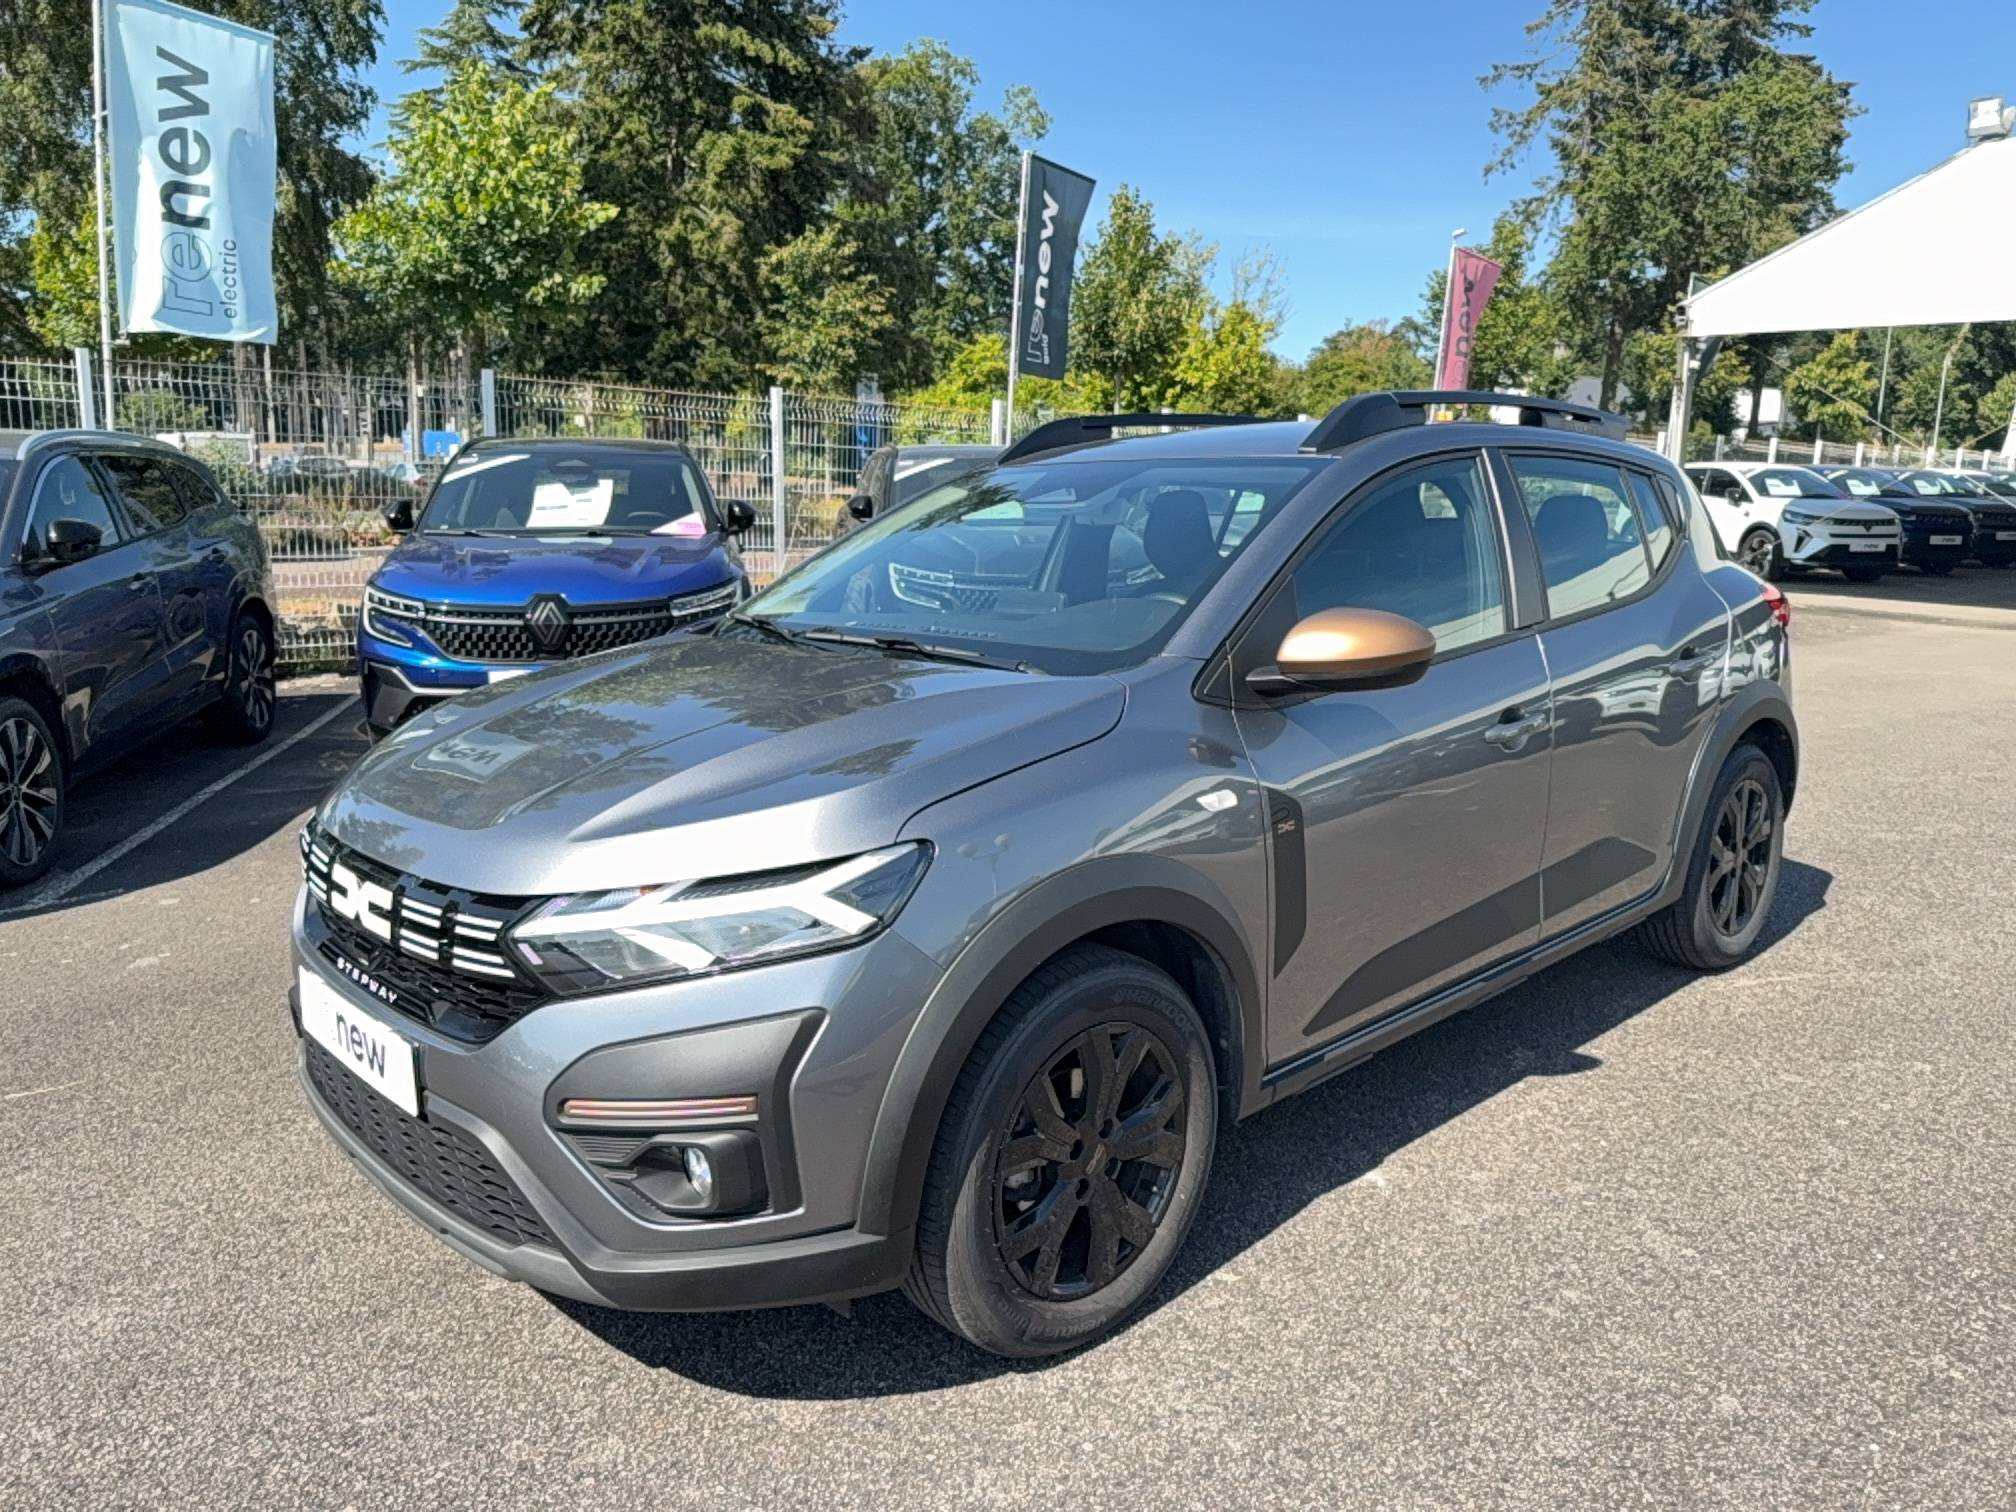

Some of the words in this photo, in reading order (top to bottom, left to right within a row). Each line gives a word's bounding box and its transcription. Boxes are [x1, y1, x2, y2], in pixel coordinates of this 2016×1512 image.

[156, 45, 213, 317] renew
[219, 238, 237, 319] electric
[1026, 189, 1059, 364] renew
[336, 957, 397, 1004] STEPWAY
[335, 1011, 386, 1079] new
